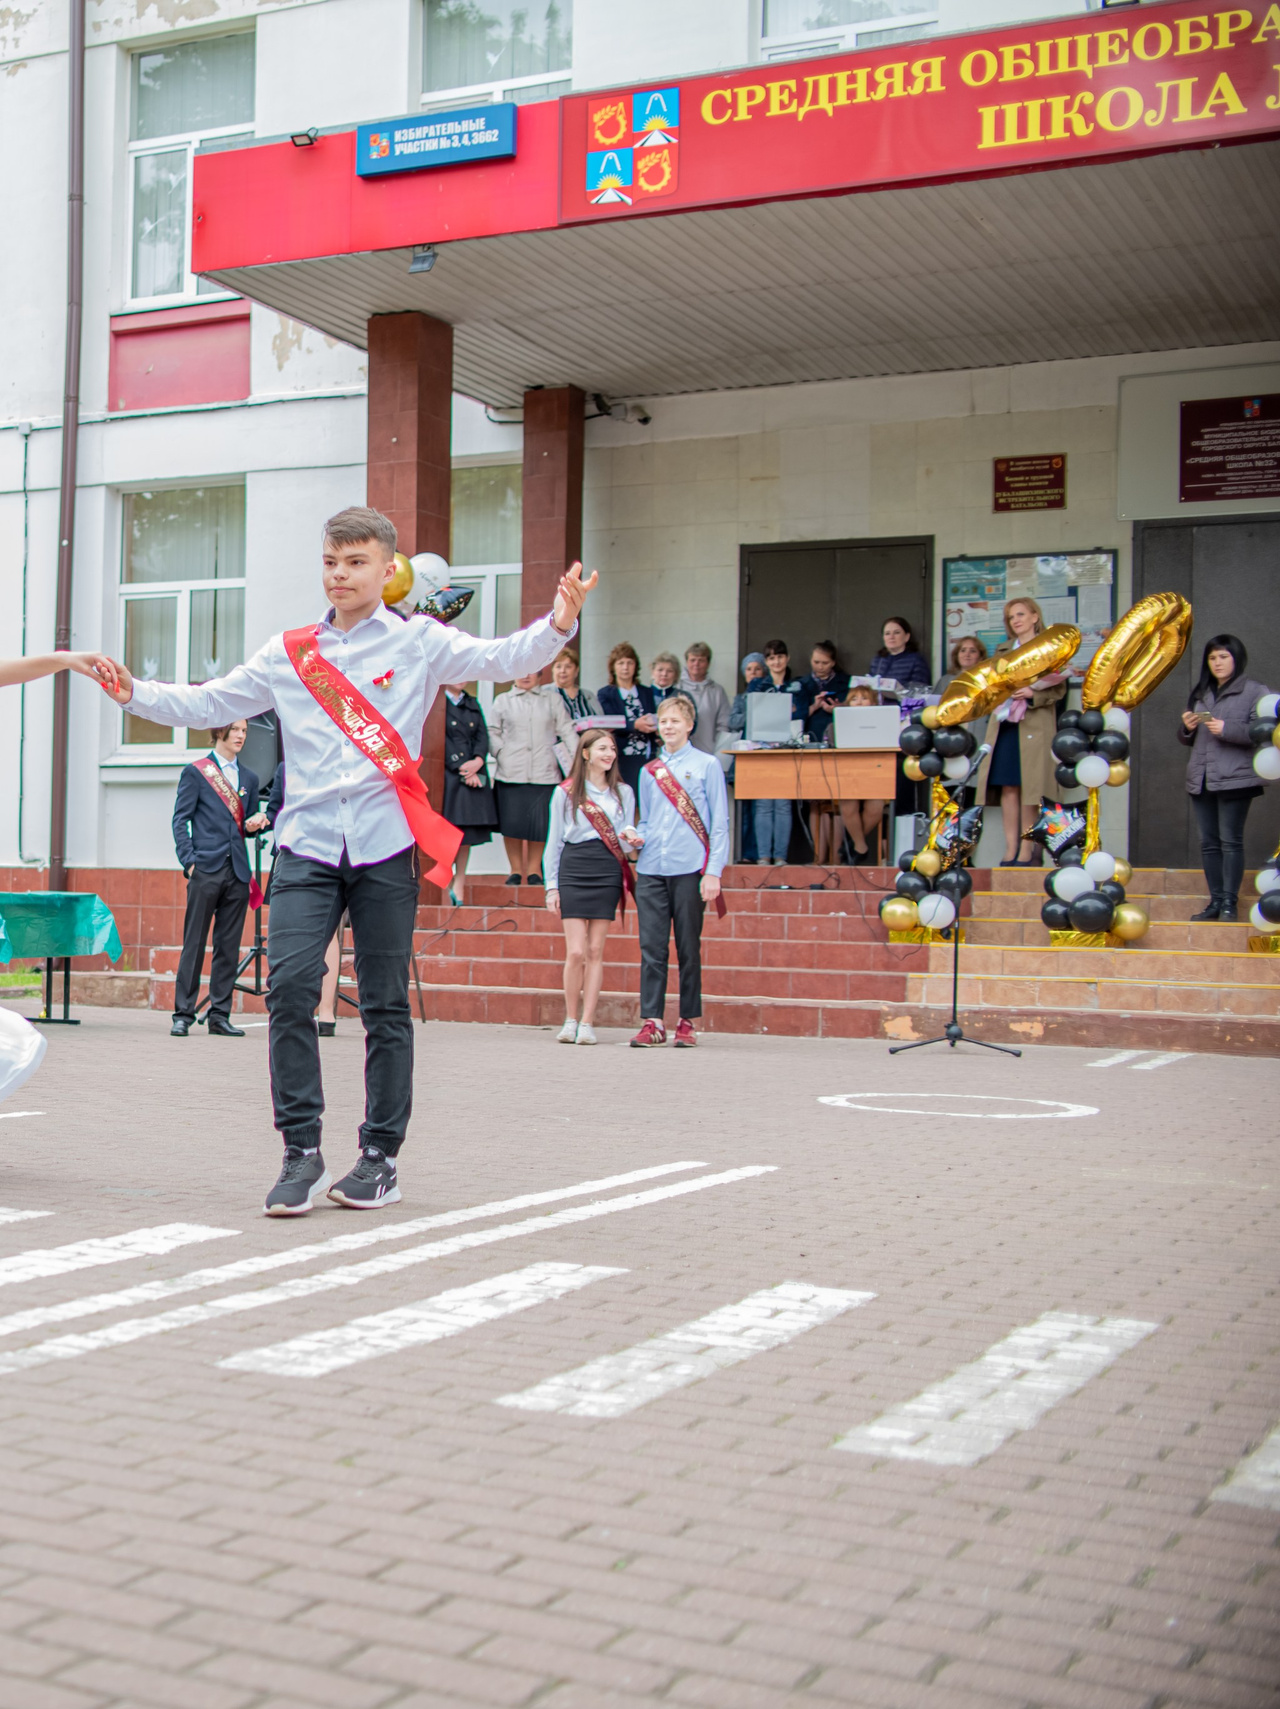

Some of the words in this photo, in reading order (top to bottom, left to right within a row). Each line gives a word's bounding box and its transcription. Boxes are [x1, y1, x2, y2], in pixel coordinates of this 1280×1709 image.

[700, 57, 947, 126] СРЕДНЯЯ
[977, 72, 1247, 150] ШКОЛА
[394, 117, 486, 143] ИЗБИРАТЕЛЬНЫЕ
[394, 138, 439, 156] УЧАСТКИ
[1226, 461, 1254, 469] ШКОЛА
[299, 658, 366, 732] Выпускник
[353, 723, 381, 740] 9
